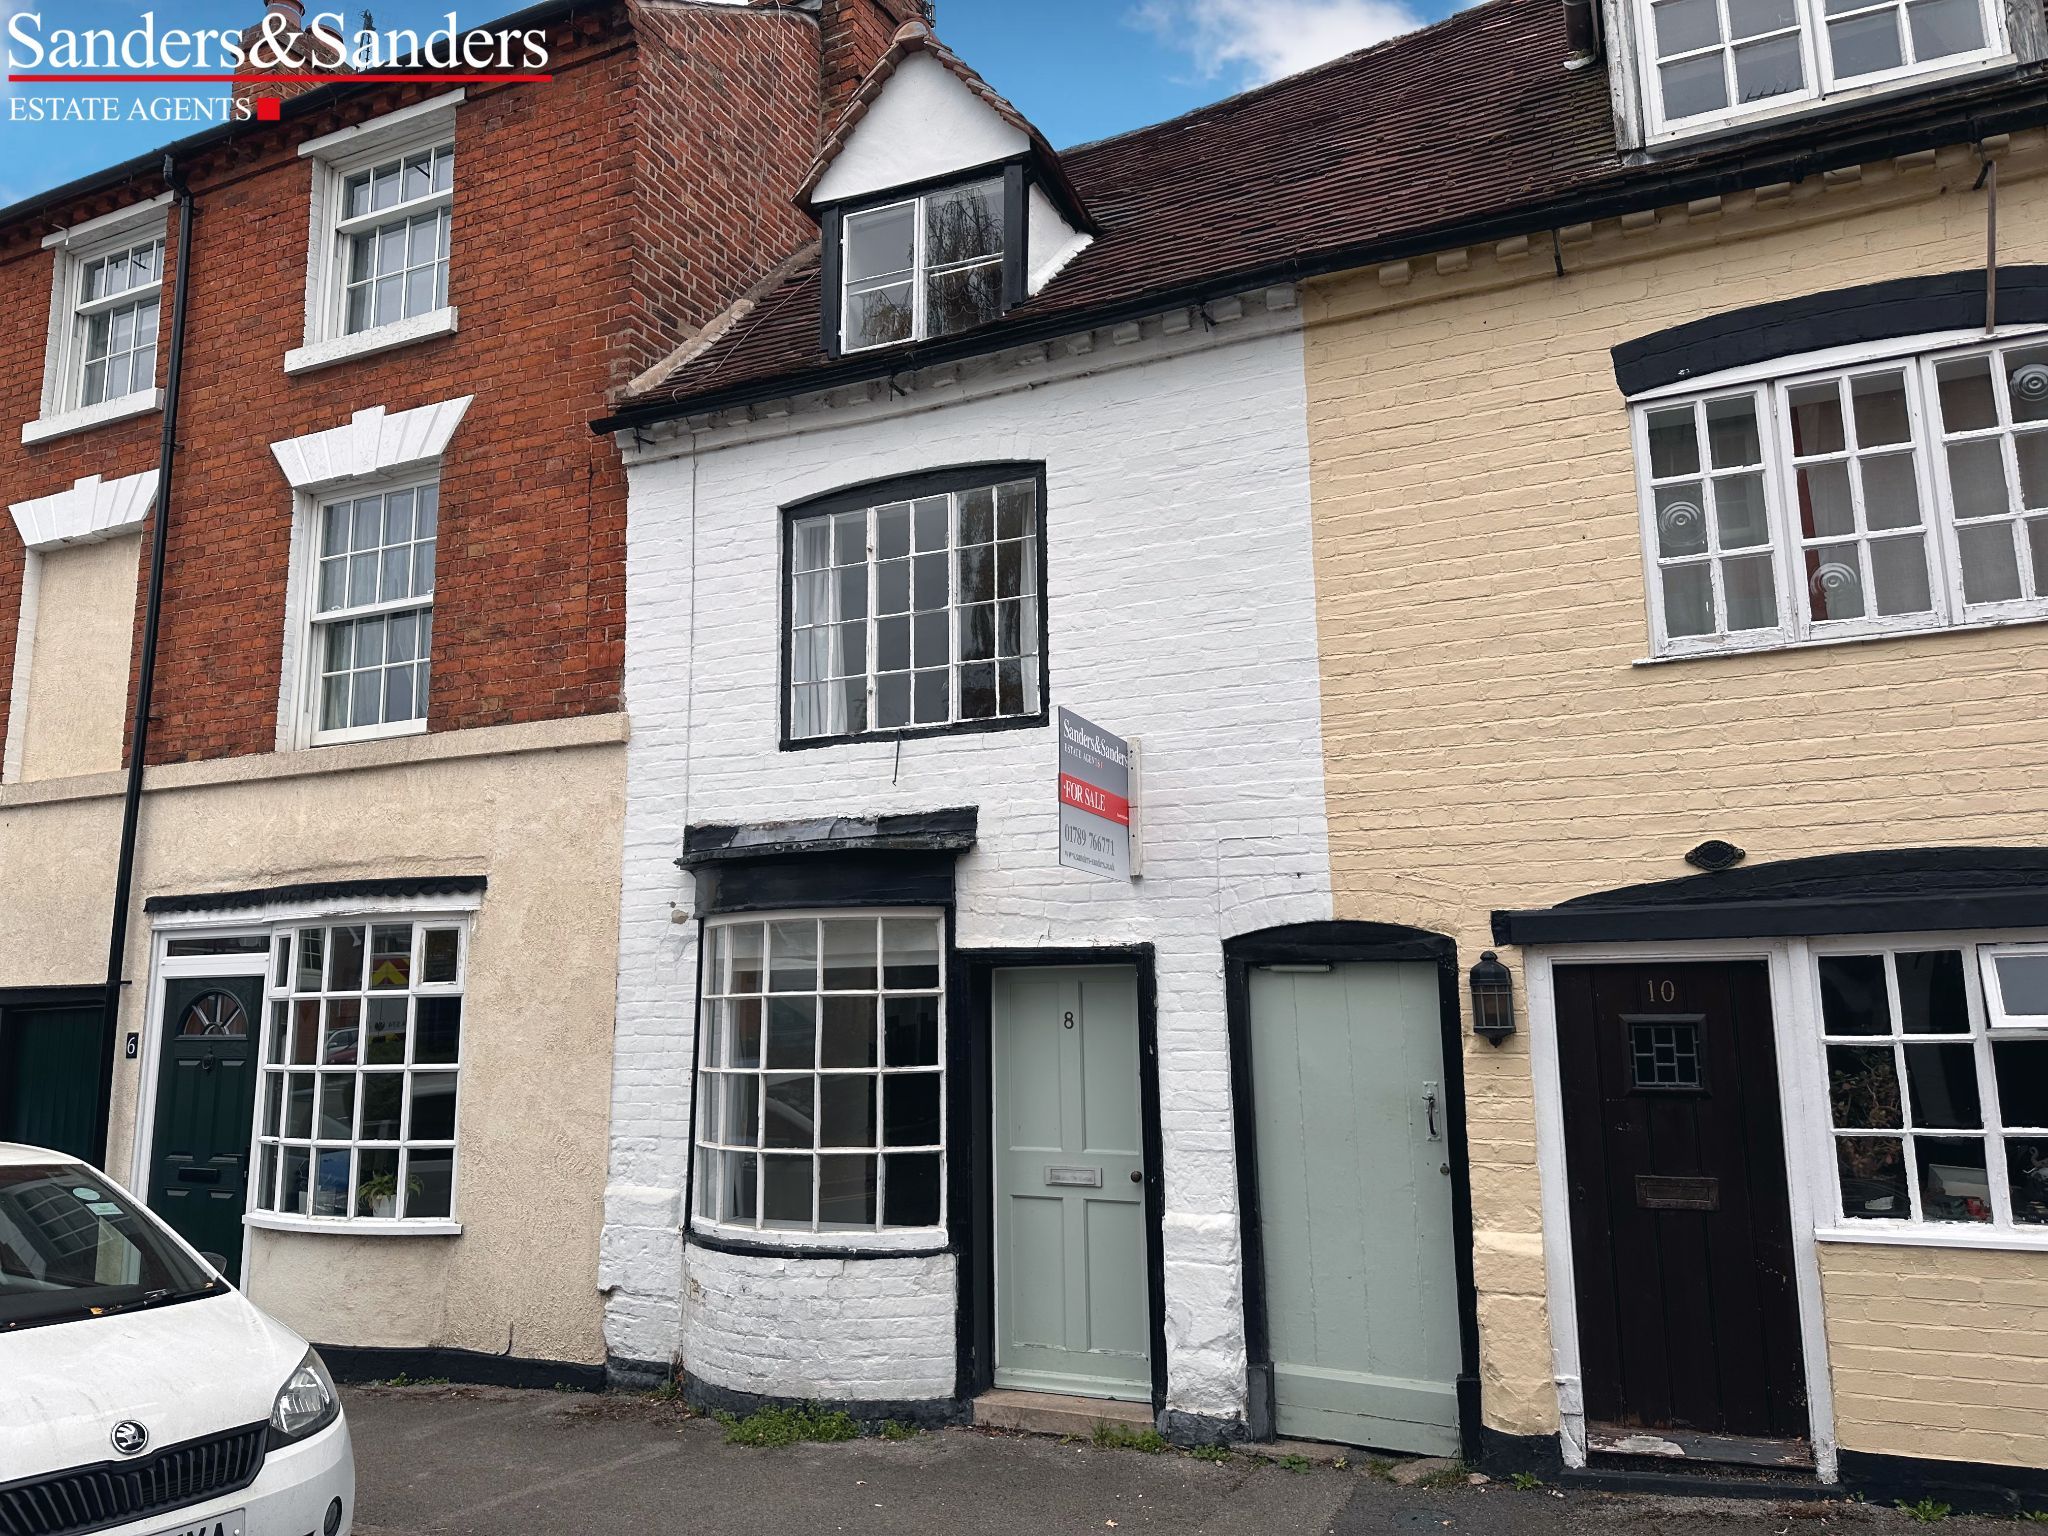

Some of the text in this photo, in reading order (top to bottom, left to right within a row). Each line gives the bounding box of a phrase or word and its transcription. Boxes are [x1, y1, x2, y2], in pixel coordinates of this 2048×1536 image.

[1063, 718, 1128, 768] Sanders&Sanders
[1064, 743, 1082, 758] ESTATE
[1065, 779, 1106, 812] FOR SALE
[1064, 823, 1115, 857] 01789 766771
[1647, 979, 1675, 1002] 10
[1064, 1011, 1074, 1030] 8
[127, 1036, 136, 1055] 6
